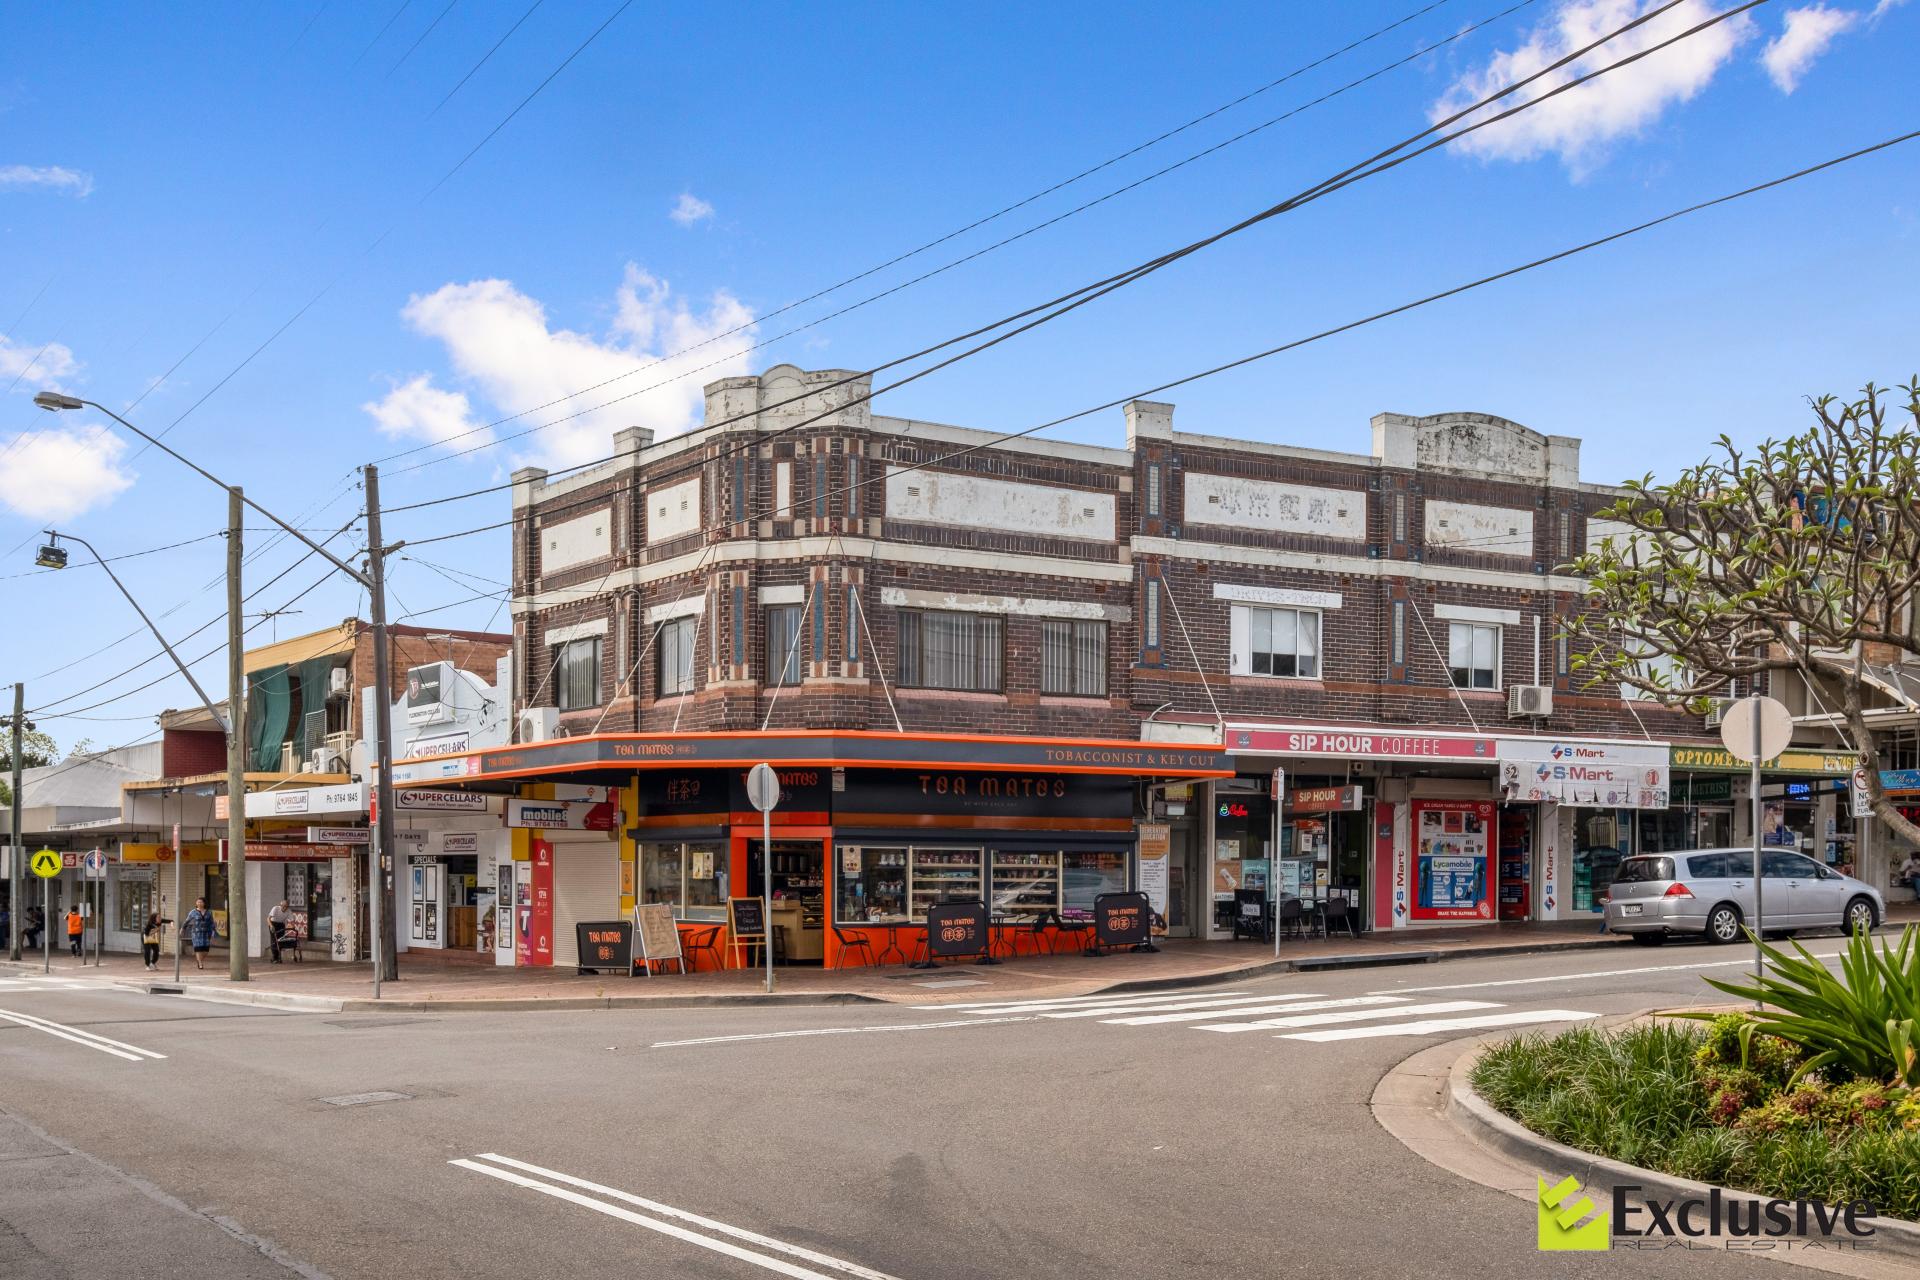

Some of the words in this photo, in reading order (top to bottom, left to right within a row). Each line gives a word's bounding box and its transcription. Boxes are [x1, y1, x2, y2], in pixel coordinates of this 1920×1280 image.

[1289, 733, 1318, 751] SIP
[1322, 735, 1372, 753] HOUR
[1381, 737, 1440, 755] COFFEE
[1045, 749, 1143, 763] TOBACCONIST
[1147, 754, 1155, 764] &
[1160, 754, 1184, 765] KEY
[1189, 754, 1216, 766] CUT
[1564, 747, 1605, 758] S-Mart
[1553, 765, 1614, 781] S-Mart
[1298, 791, 1312, 802] SIP
[1313, 790, 1336, 801] HOUR
[414, 856, 437, 864] SPECIALS
[1433, 859, 1473, 869] Lycamobile
